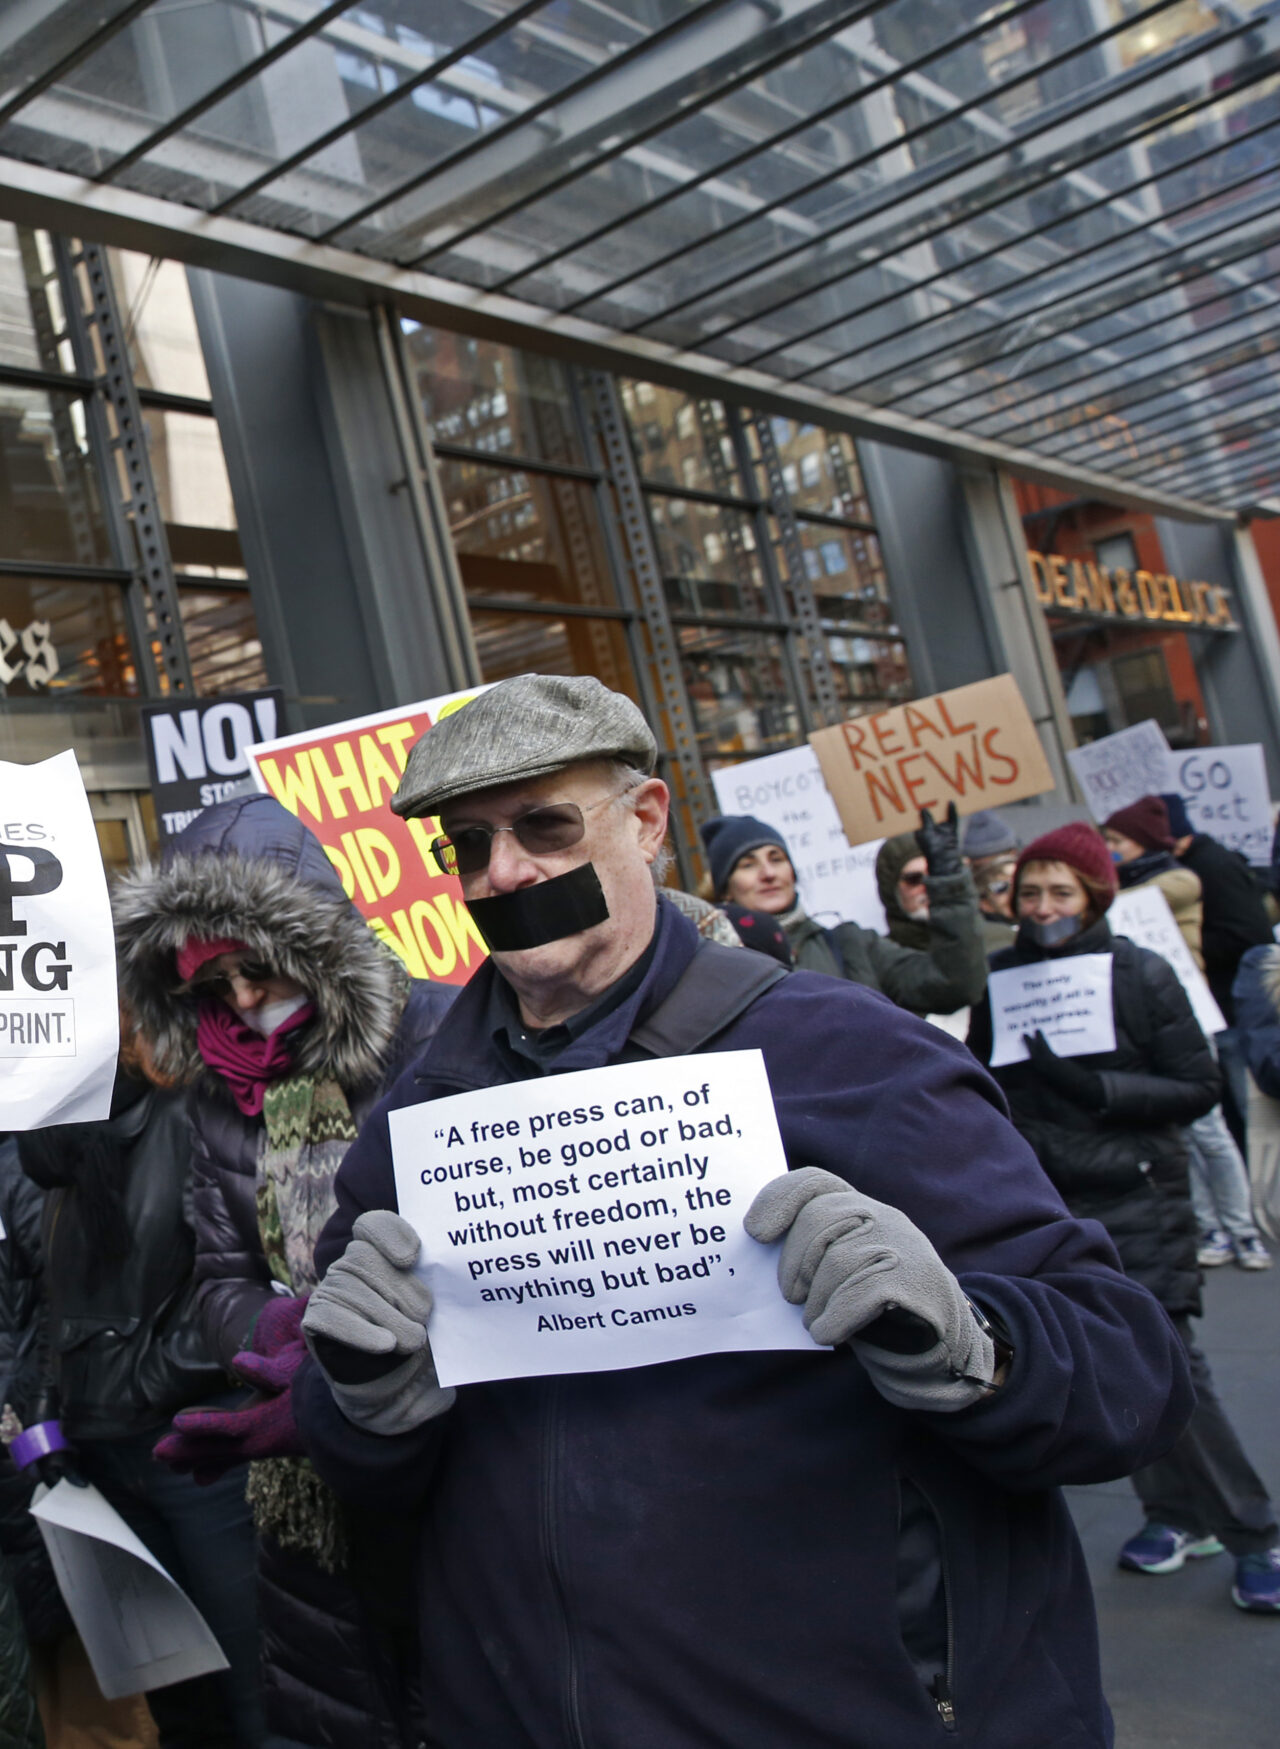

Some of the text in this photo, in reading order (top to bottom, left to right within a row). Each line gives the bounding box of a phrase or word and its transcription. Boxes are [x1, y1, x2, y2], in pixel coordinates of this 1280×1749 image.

[1027, 549, 1116, 617] DEAN
[150, 698, 277, 783] NO!
[842, 697, 978, 770] REAL
[200, 780, 242, 806] STO
[258, 722, 415, 823] WHAT
[735, 767, 823, 810] BOYCOT
[864, 726, 1018, 822] NEWS
[1179, 755, 1232, 792] GO
[367, 893, 490, 978] NOW
[434, 1083, 712, 1148] “A free press can, of
[420, 1115, 743, 1185] course, be good or bad,
[454, 1152, 710, 1213] but, most certainly
[448, 1185, 732, 1246] without freedom, the
[467, 1222, 726, 1280] press will never be
[480, 1274, 595, 1304] anything
[602, 1266, 650, 1291] but
[536, 1301, 697, 1333] Albert Camus
